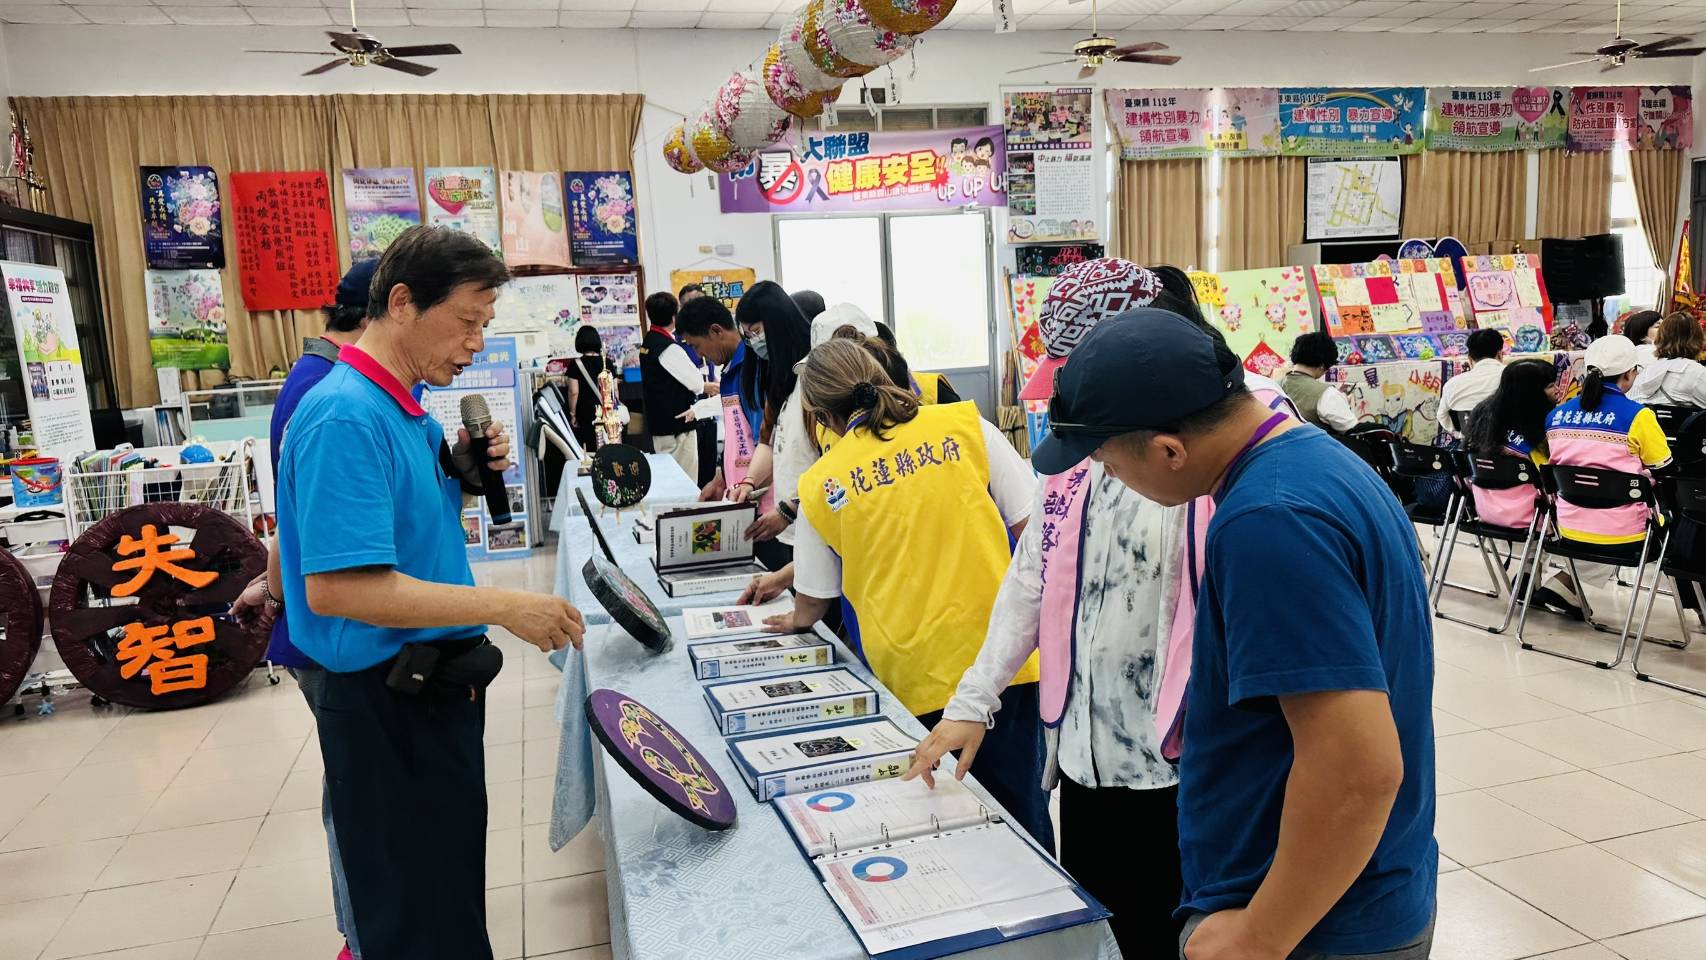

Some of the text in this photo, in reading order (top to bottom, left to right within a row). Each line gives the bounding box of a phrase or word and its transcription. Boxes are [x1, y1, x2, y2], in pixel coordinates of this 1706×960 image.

[1293, 107, 1394, 122] 建構性別 暴力宣導
[1441, 101, 1513, 118] 建構性別暴力
[1586, 102, 1625, 114] 性別暴力
[1125, 110, 1200, 126] 建構性別暴力
[1572, 117, 1638, 130] 防治社區服方案
[1139, 128, 1191, 144] 領航宣導
[1452, 120, 1502, 136] 領航宣導
[937, 184, 957, 201] UP
[963, 177, 985, 198] UP
[849, 437, 961, 496] 花蓮縣政府
[110, 523, 220, 696] 失智
